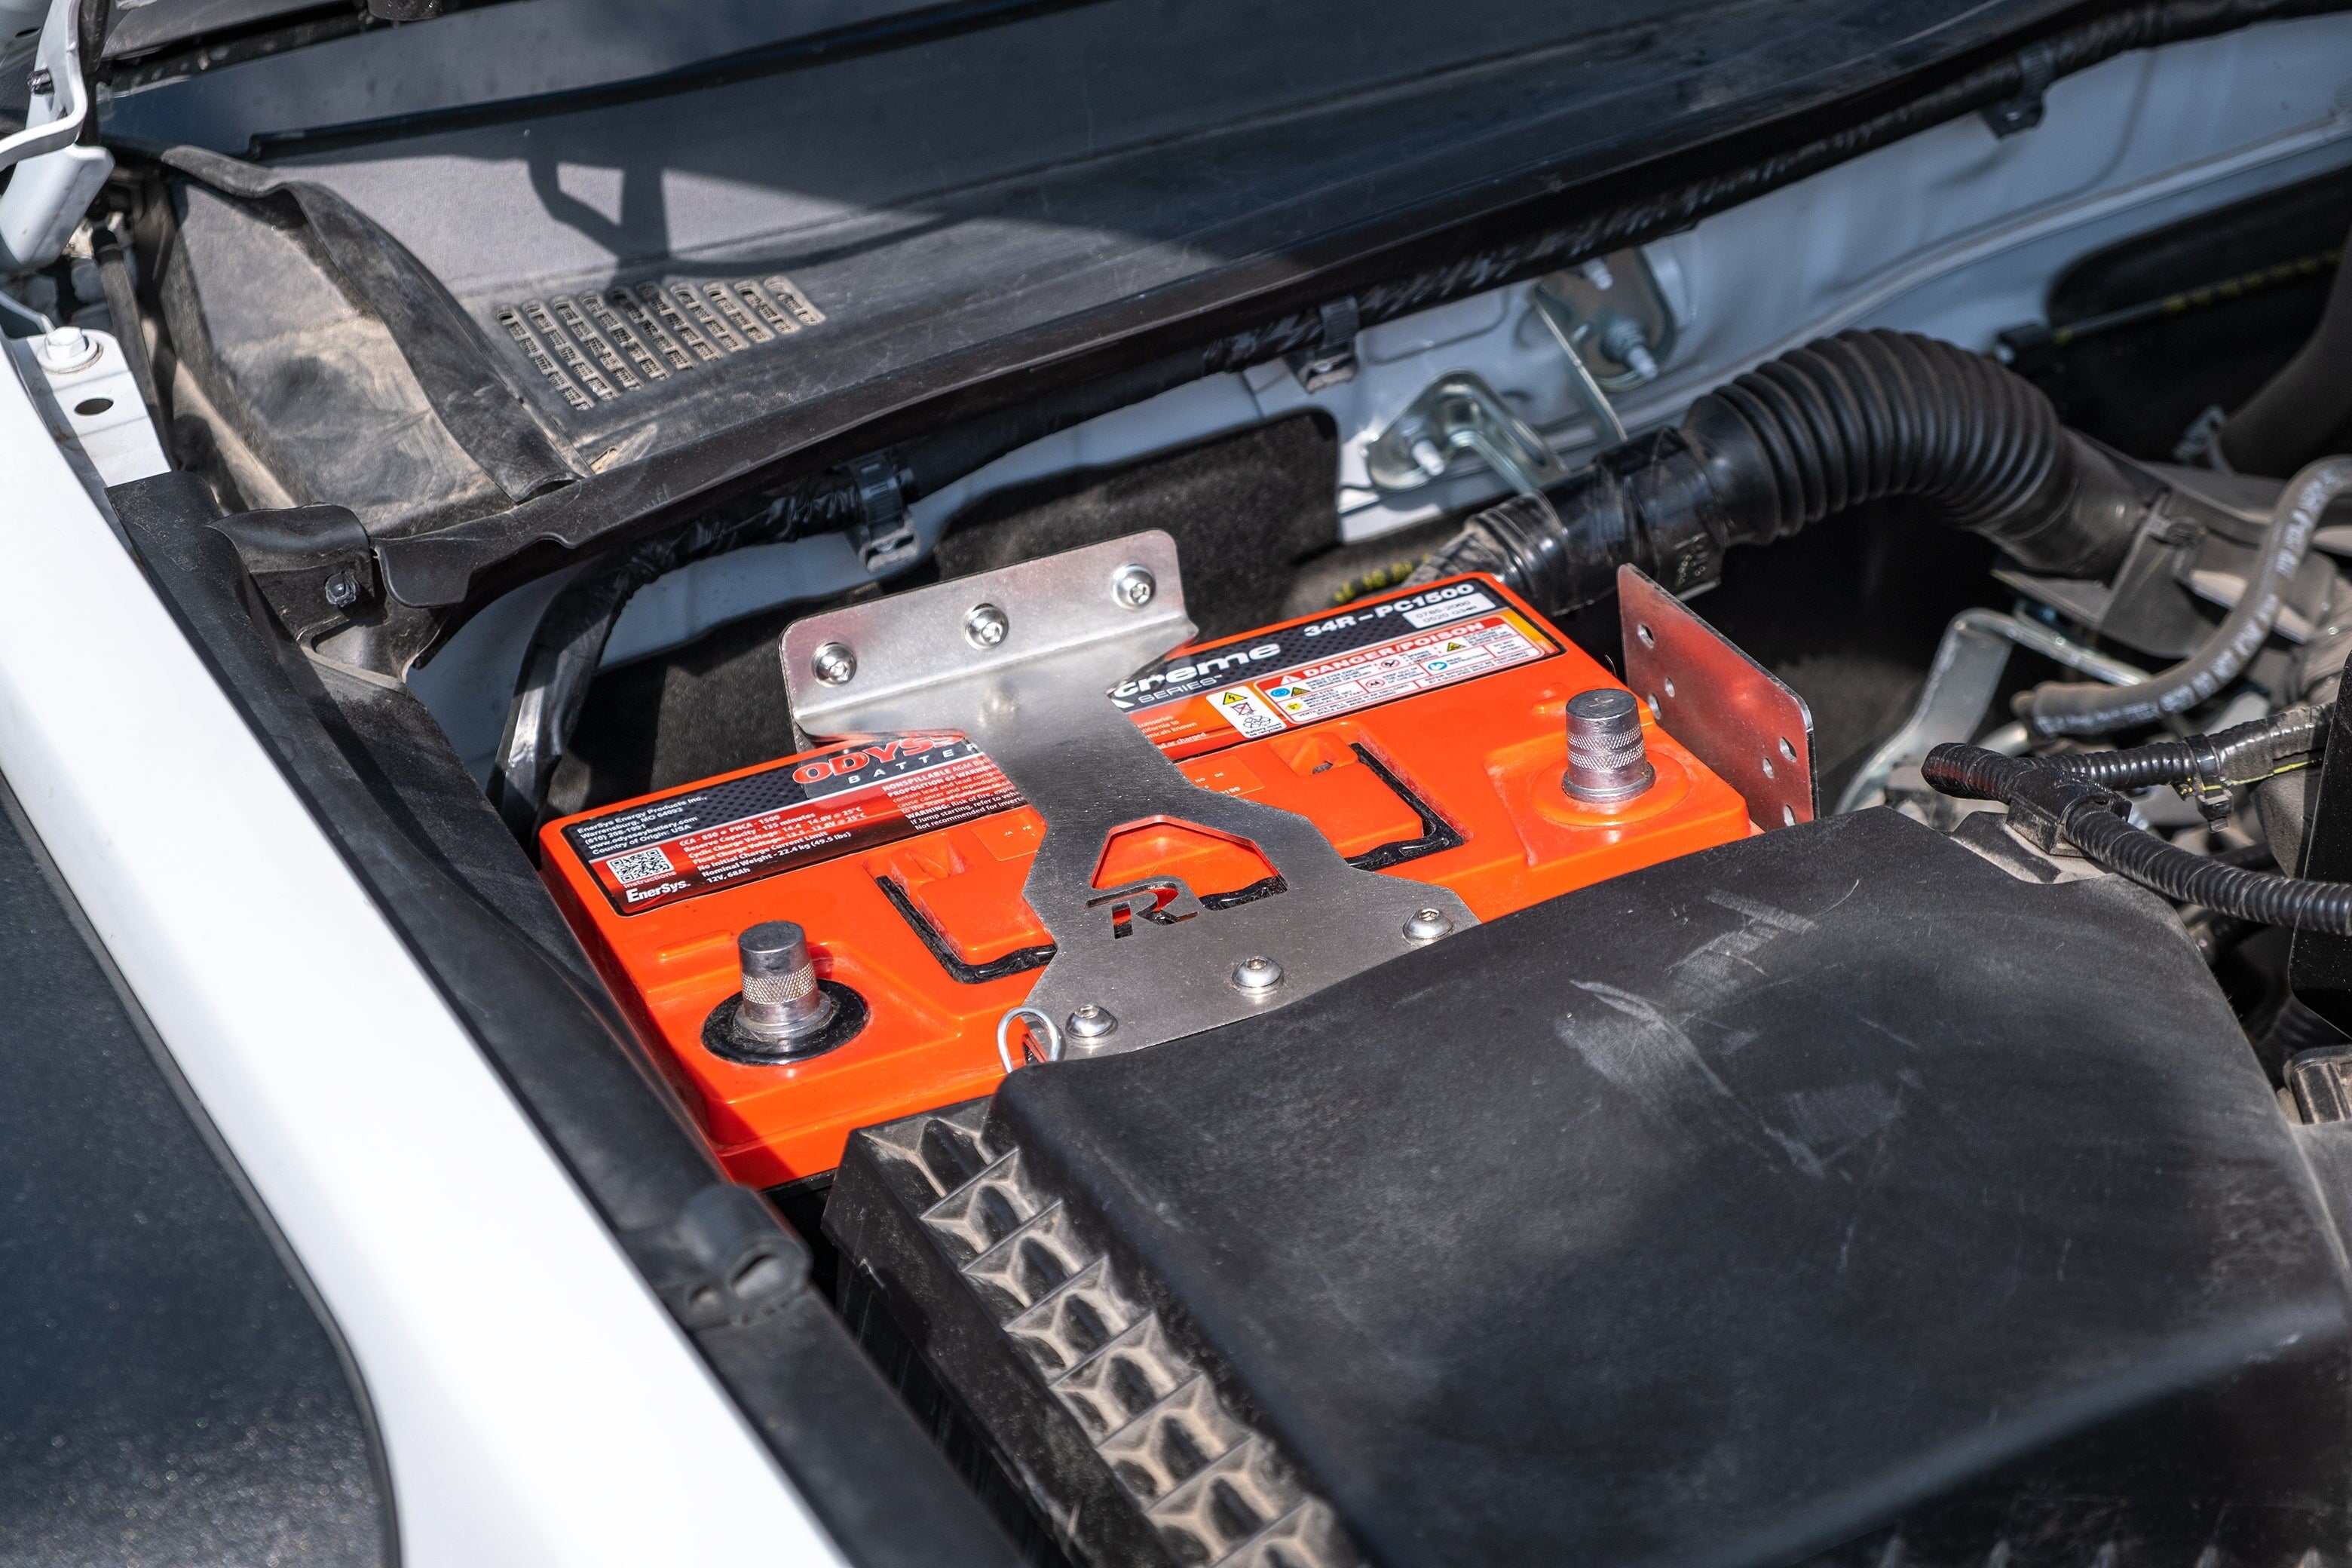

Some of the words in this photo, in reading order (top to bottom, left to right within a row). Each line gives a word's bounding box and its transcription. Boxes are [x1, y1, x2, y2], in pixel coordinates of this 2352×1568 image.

[1303, 622, 1485, 678] DANGER/POISON
[1171, 721, 1197, 732] known
[882, 769, 951, 792] NONSPILLABLE
[953, 763, 972, 772] AGM
[887, 778, 944, 798] PROPOSITION
[893, 792, 920, 803] contain
[921, 786, 939, 795] lead
[954, 777, 972, 786] lead
[898, 800, 918, 808] cause
[920, 792, 944, 802] cancer
[924, 798, 945, 807] State
[955, 786, 993, 798] California
[577, 821, 614, 834] EnerSys
[614, 812, 646, 823] Energy
[647, 801, 687, 814] Products
[580, 821, 639, 839] Warrensburg,
[657, 807, 683, 817] 64093
[729, 822, 753, 832] PHCA
[758, 815, 780, 824] 1500
[905, 804, 951, 819] WARNING:
[918, 814, 939, 823] Jump
[940, 805, 973, 816] starting,
[973, 799, 991, 807] refer
[931, 807, 986, 826] recommended
[585, 835, 607, 845] (610)
[608, 824, 646, 838] 208-1991
[589, 817, 698, 850] www.odysseybattery.com
[593, 842, 627, 855] Country
[639, 831, 669, 841] Origin:
[671, 825, 691, 833] USA
[684, 841, 718, 853] Reserve
[719, 829, 756, 842] Capacity
[779, 813, 816, 825] minutes
[688, 849, 712, 859] Cyclic
[713, 841, 744, 851] Charge
[744, 831, 781, 843] Voltage:
[782, 823, 801, 832] 14.4
[807, 815, 831, 825] 14.8V
[693, 855, 716, 865] Float
[716, 847, 748, 858] Charge
[747, 837, 786, 849] Voltage:
[811, 822, 836, 831] 13.8V
[702, 862, 740, 877] Nominal
[740, 854, 773, 866] Weight
[777, 847, 798, 856] 22.4
[810, 837, 834, 847] (49.5
[711, 856, 738, 867] Initial
[739, 848, 770, 859] Charge
[770, 838, 804, 850] Current
[804, 831, 828, 841] Limit
[623, 871, 677, 889] Instructions
[706, 874, 727, 883] 12V,
[727, 868, 751, 877] 68Ah
[626, 880, 688, 903] EnerSys
